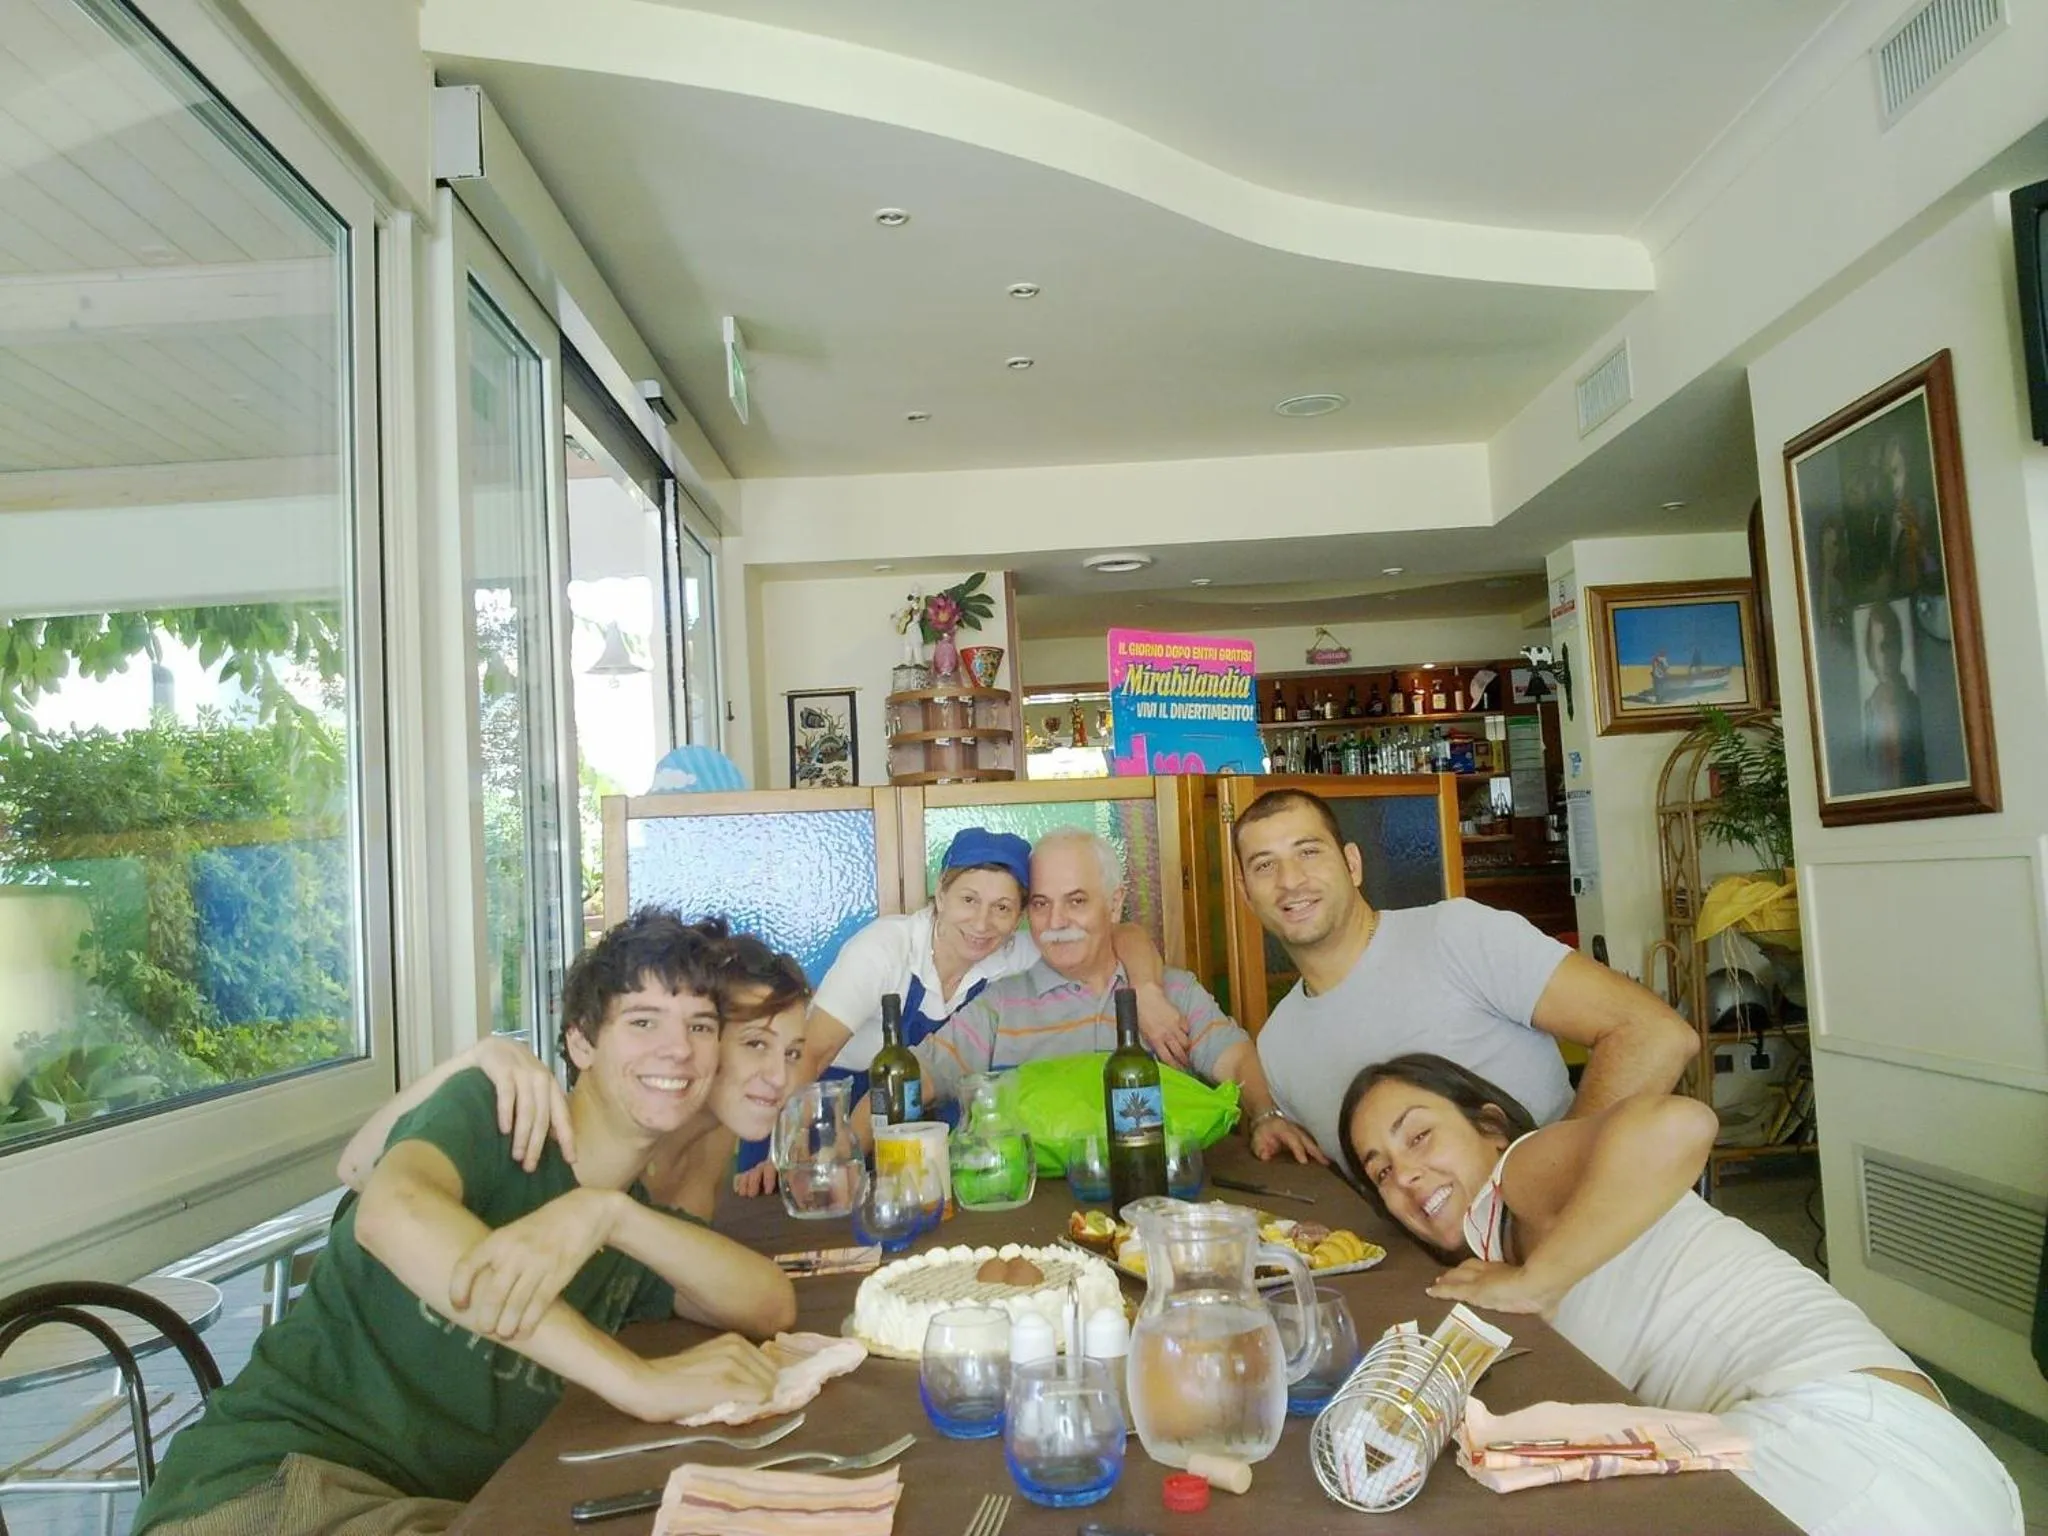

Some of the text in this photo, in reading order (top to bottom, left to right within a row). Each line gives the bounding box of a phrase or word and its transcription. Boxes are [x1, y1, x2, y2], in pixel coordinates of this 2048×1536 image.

[1128, 643, 1163, 657] GIORNO
[1165, 645, 1191, 658] DOPO
[1192, 647, 1218, 660] ENTRI
[1122, 663, 1251, 698] Mirabilandia
[1136, 702, 1254, 721] VIVI IL DIVERTIMENTO!
